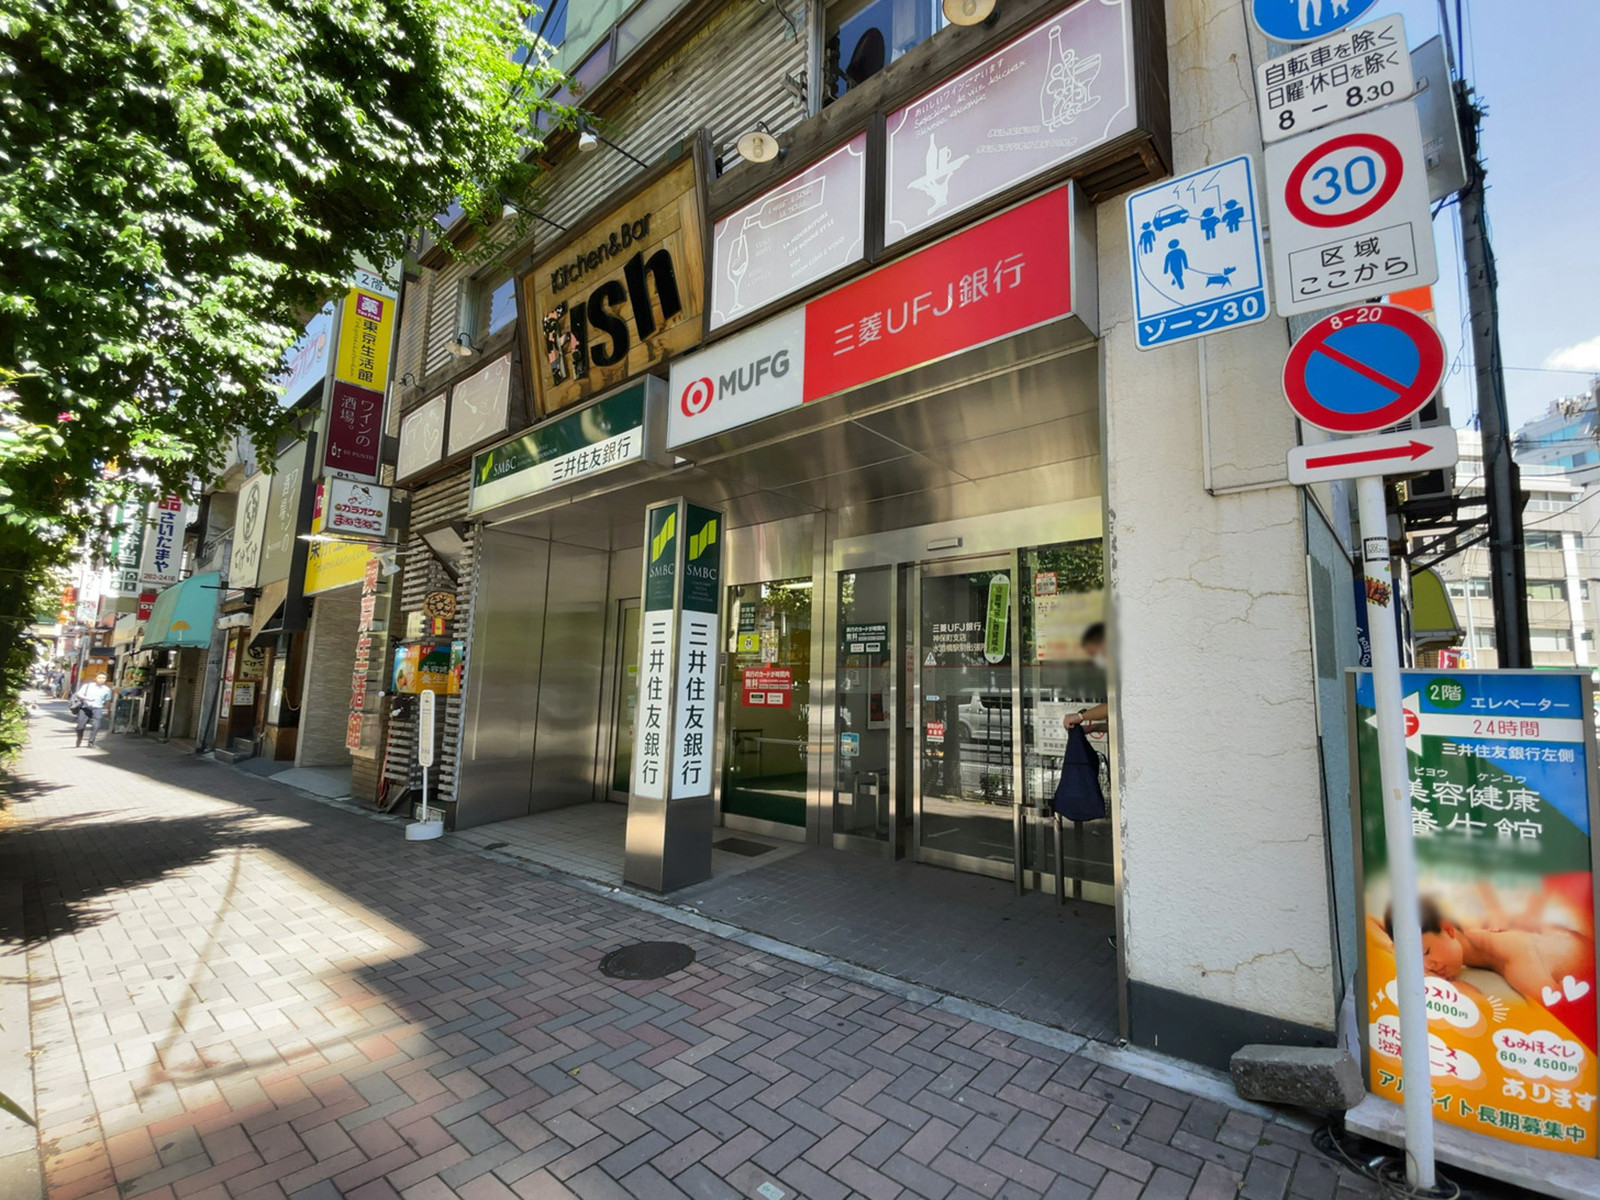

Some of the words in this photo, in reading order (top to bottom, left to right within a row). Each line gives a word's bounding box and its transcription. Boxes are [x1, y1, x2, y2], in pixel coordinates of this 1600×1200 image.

[1265, 25, 1395, 86] 自転車を除く
[1278, 110, 1295, 130] 8
[1346, 81, 1394, 108] 8.30
[1312, 155, 1377, 205] 30
[551, 213, 651, 294] Kitchen&Bar
[1321, 237, 1380, 268] 区域
[1300, 256, 1408, 295] ここから
[361, 296, 380, 314] 薬
[833, 253, 1026, 356] 三菱UFJ銀行
[1144, 296, 1258, 342] ゾーン30
[1330, 307, 1382, 329] 8-20
[358, 320, 378, 383] 東京生活館
[719, 349, 790, 401] MUFG
[355, 400, 374, 447] ワインの
[493, 455, 517, 477] SMBC
[552, 436, 631, 481] 三井住友銀行
[342, 504, 376, 516] カラオケ
[154, 511, 176, 572] さいたまや
[649, 563, 674, 578] SMBC
[686, 564, 717, 580] SMBC
[932, 621, 981, 633] 三菱UFJ銀行
[642, 622, 666, 785] 三井住友銀行
[682, 623, 708, 786] 三井住友銀行
[1430, 684, 1462, 702] 2階
[1471, 697, 1570, 712] エレベーター
[1473, 719, 1540, 738] 24時間
[1442, 742, 1575, 763] 三井住友銀行左側
[1408, 778, 1541, 813] 美容健康
[1477, 772, 1527, 785] ケンコウ
[1500, 1050, 1528, 1065] 60分
[1533, 1056, 1578, 1074] 4500円
[1501, 1034, 1576, 1058] もみほぐし
[1502, 1076, 1597, 1112] あります
